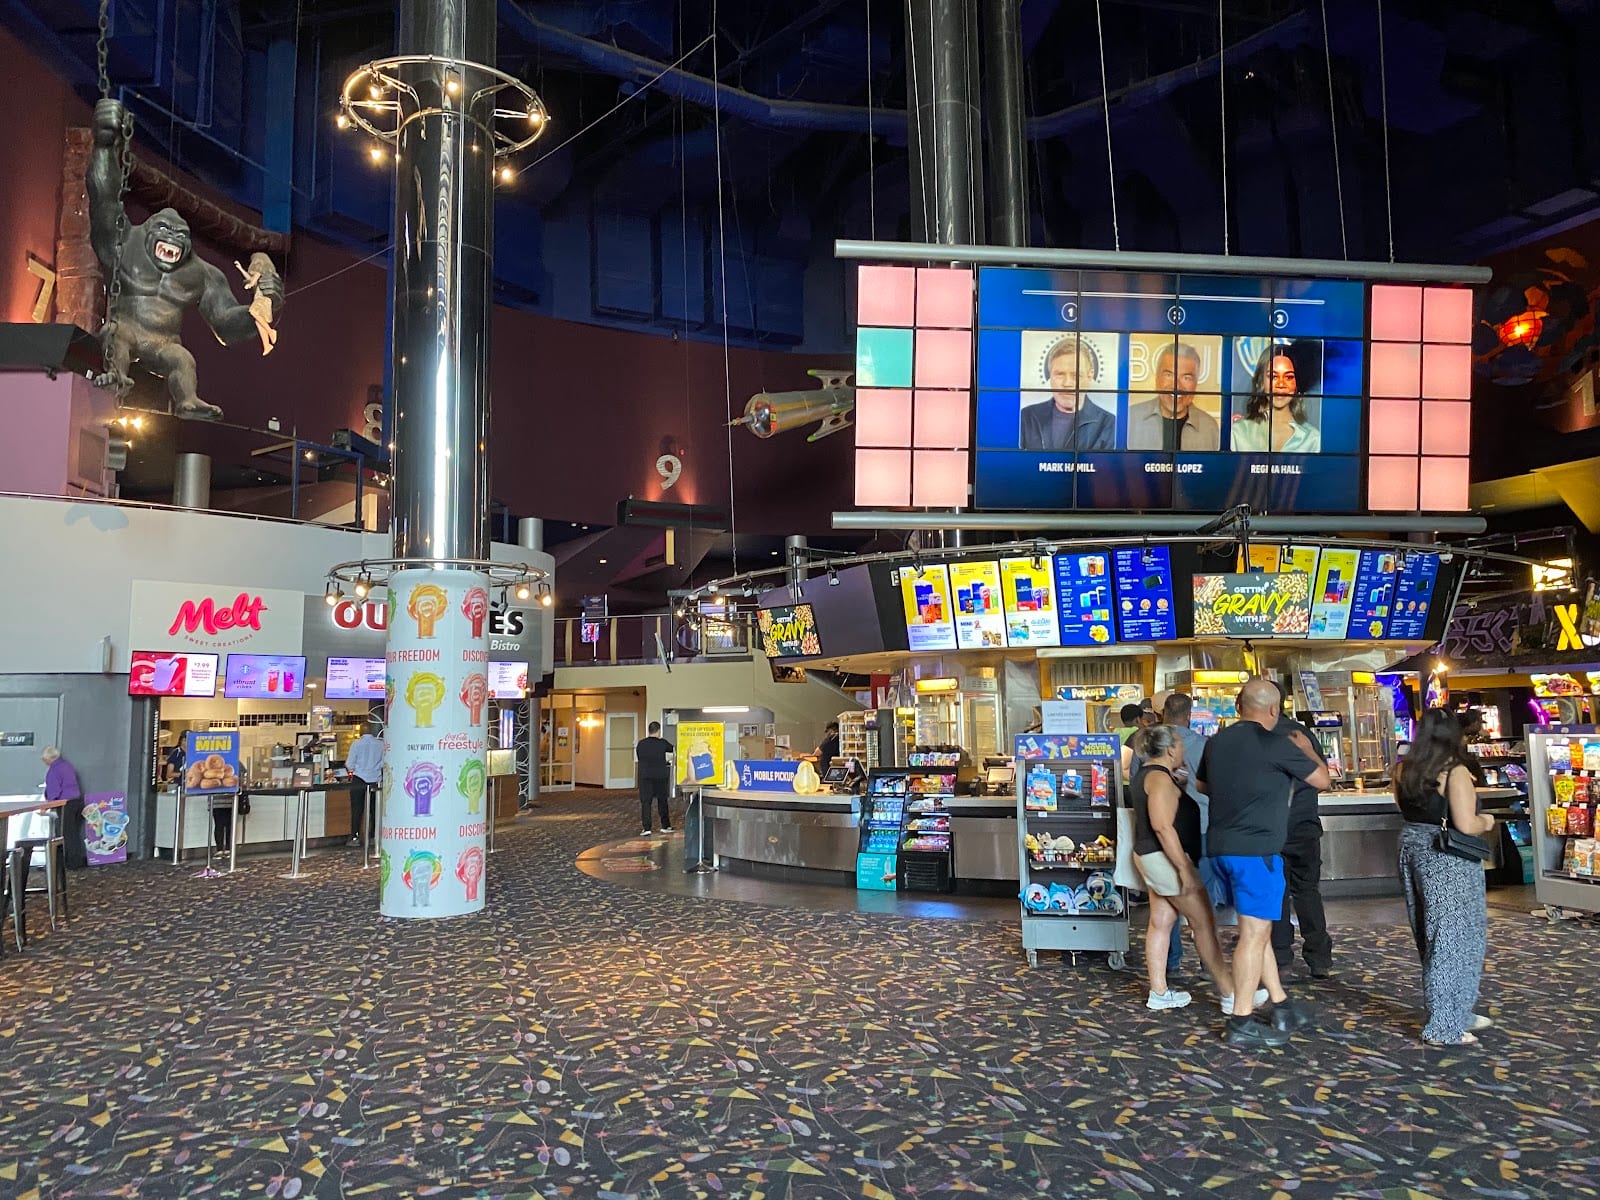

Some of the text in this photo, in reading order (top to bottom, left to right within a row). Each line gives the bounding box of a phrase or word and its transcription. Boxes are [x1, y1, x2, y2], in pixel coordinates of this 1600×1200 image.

[27, 257, 56, 324] 7
[1067, 307, 1074, 318] 1
[1276, 314, 1284, 324] 3
[1571, 370, 1597, 417] 1
[363, 402, 383, 447] 8
[655, 453, 682, 490] 9
[1038, 462, 1096, 473] MARK HAMILL
[1177, 463, 1203, 473] LOPEZ
[1280, 464, 1301, 474] HALL
[1213, 592, 1291, 616] GRAVY
[167, 592, 269, 636] Melt
[1235, 615, 1259, 623] WITH
[770, 620, 806, 642] GRAVY
[1553, 603, 1585, 651] X
[184, 633, 254, 648] SWEET CREATIONS
[490, 639, 521, 651] Bistro
[398, 649, 440, 662] FREEDOM
[1071, 686, 1106, 700] Popcorn
[195, 739, 232, 751] MINI
[407, 743, 434, 751] ONLY WITH
[438, 738, 483, 754] freestyle
[753, 770, 795, 782] MOBILE PICKUP
[394, 826, 437, 840] FREEDOM
